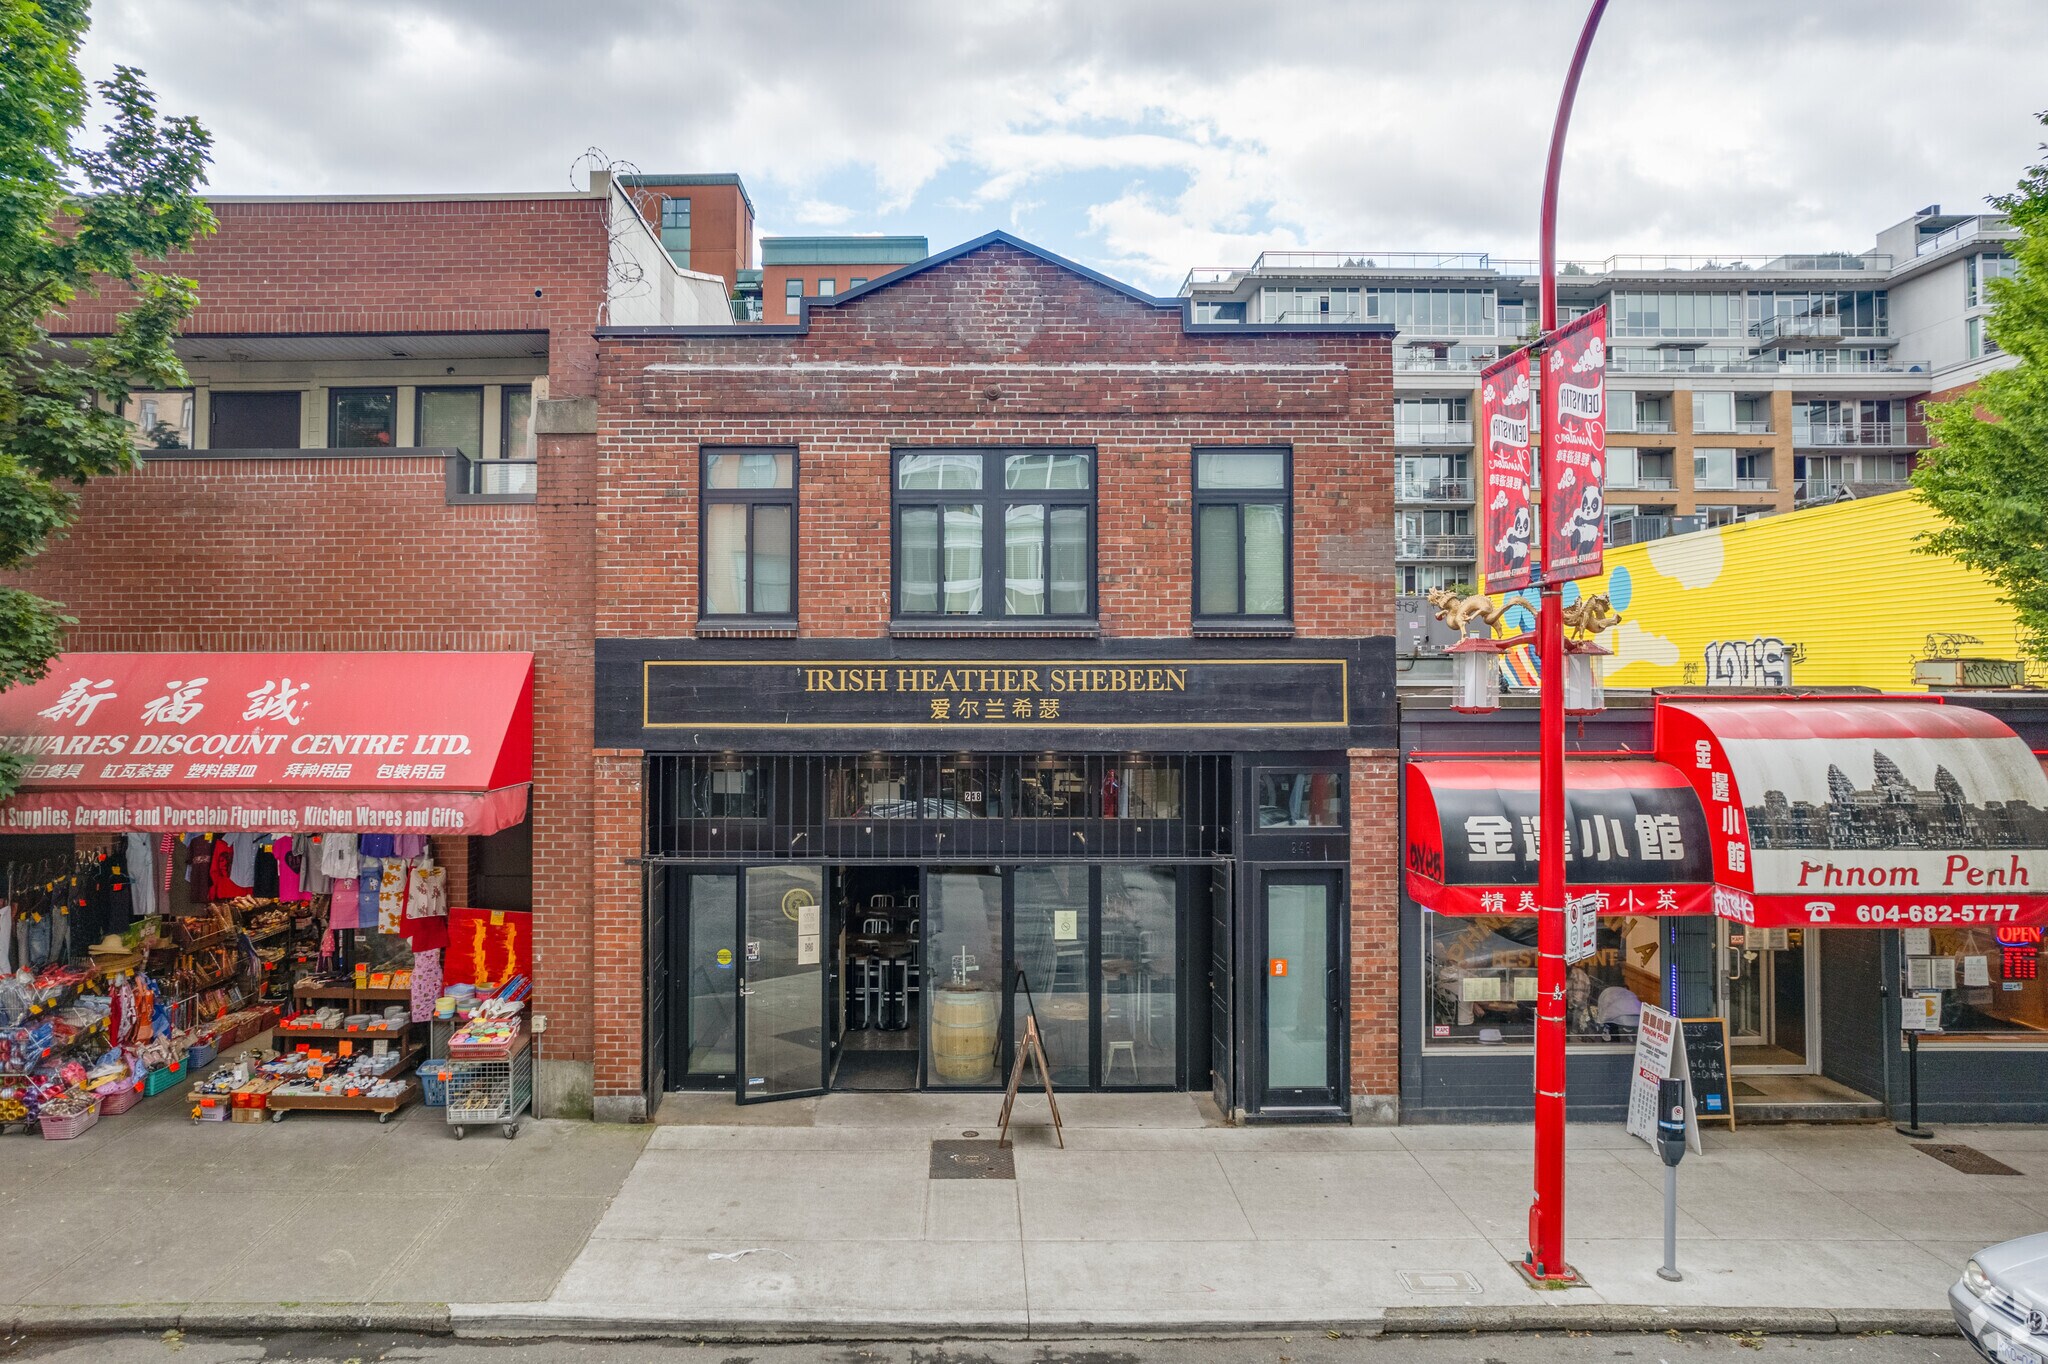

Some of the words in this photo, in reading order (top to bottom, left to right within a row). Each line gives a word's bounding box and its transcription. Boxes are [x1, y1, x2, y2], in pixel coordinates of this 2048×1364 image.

[805, 669, 888, 692] IRISH
[897, 669, 1042, 692] HEATHER
[1051, 669, 1188, 692] SHEBEEN
[930, 698, 1060, 720] 爱尔兰希瑟
[130, 734, 288, 755] DISCOUNT
[291, 734, 410, 755] CENTRE
[412, 734, 472, 755] LTD.
[184, 763, 258, 779] 塑料器皿
[282, 763, 353, 779] 拜神用品
[376, 763, 447, 779] 包裝用品
[8, 806, 72, 829] Supplies,
[75, 805, 132, 827] Ceramic
[135, 806, 160, 827] and
[163, 805, 228, 827] Porcelain
[230, 806, 300, 829] Figurines,
[304, 806, 353, 828] Kitchen
[356, 806, 402, 828] Wares
[405, 807, 429, 828] and
[431, 807, 465, 829] Gifts
[1942, 854, 2030, 887] Penh
[1480, 889, 1680, 913] 精美南小菜
[1856, 904, 2020, 923] 604-682-5777
[1998, 926, 2041, 943] OPEN
[1642, 1070, 1658, 1085] OPEN
